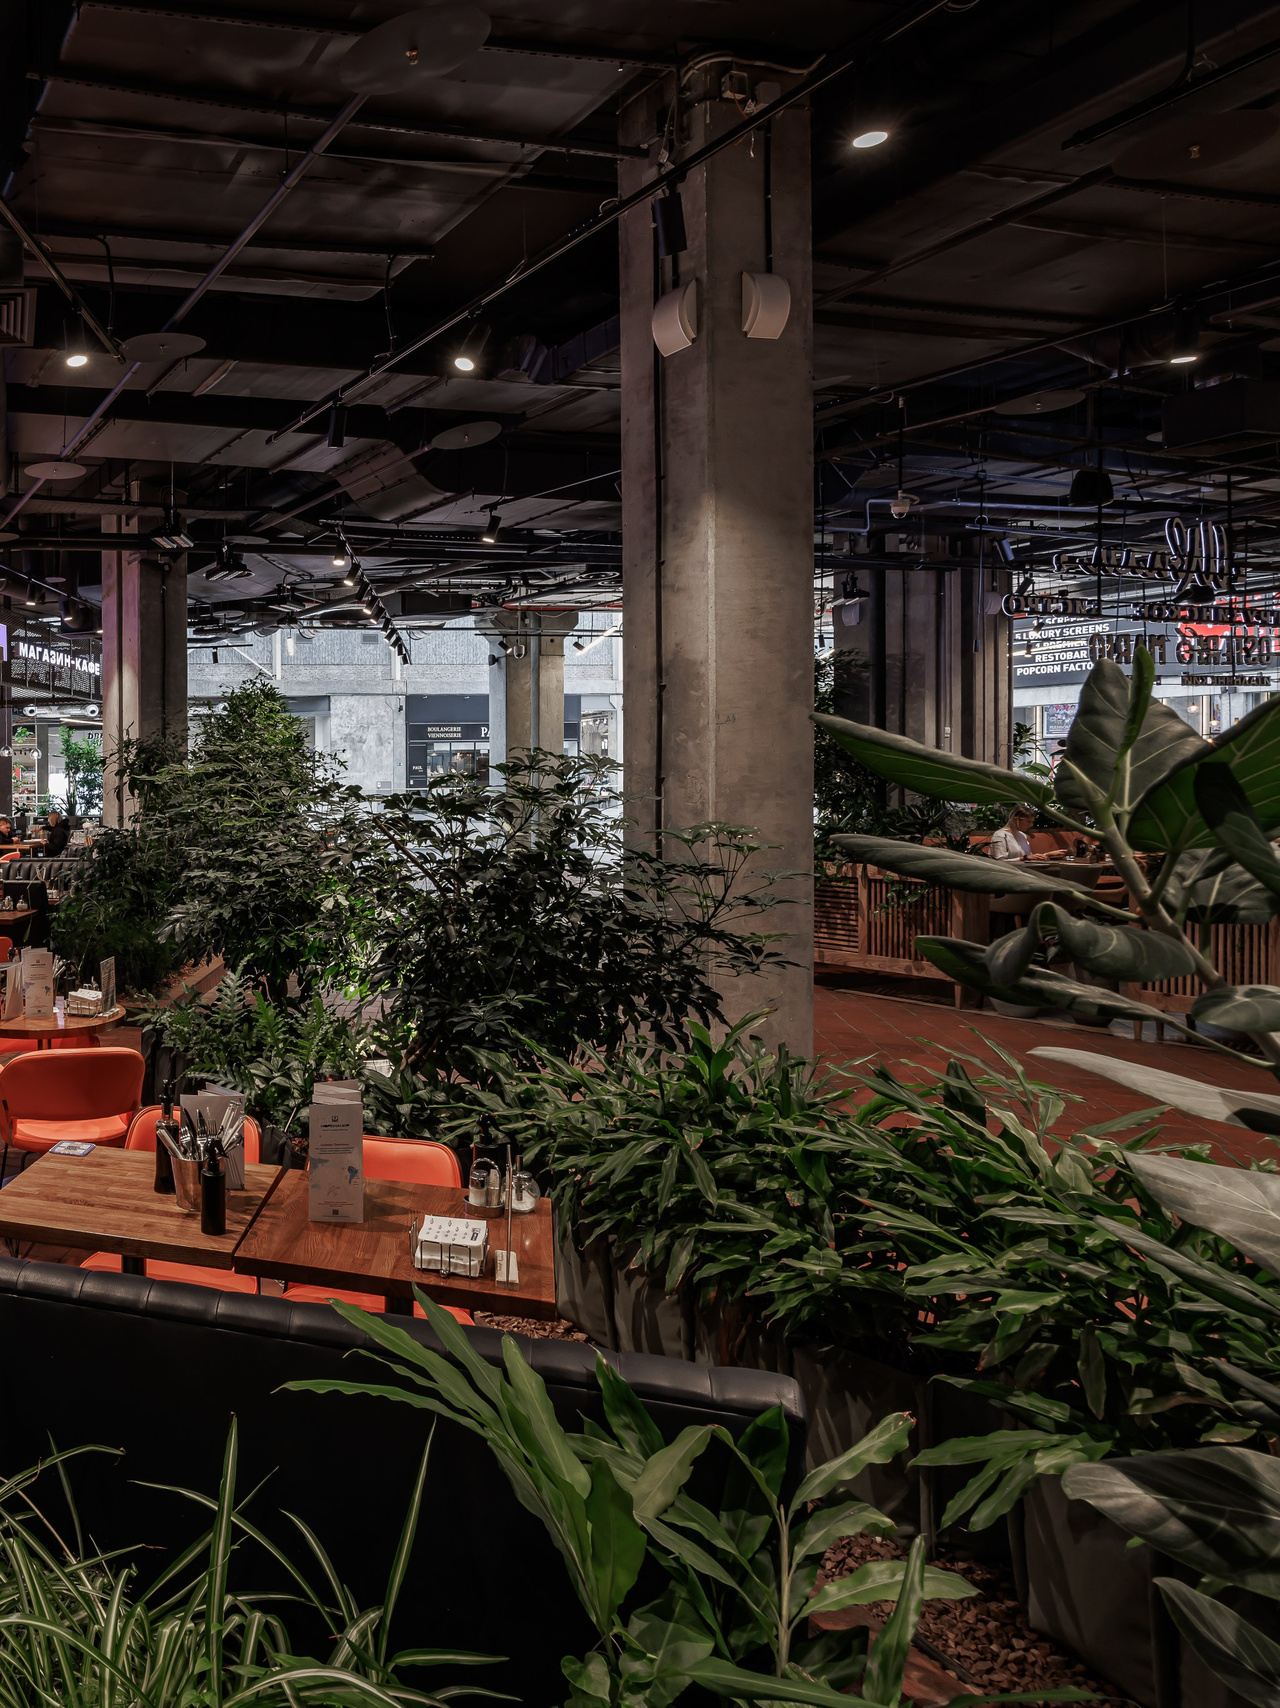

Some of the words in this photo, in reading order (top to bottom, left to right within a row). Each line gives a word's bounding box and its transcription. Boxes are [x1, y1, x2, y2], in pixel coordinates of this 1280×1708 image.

[1023, 628, 1061, 641] LUXURY
[1062, 623, 1110, 637] SCREENS
[19, 642, 101, 676] МАГАЗИН-КАФЕ
[1035, 650, 1088, 663] RESTOBAR
[1016, 664, 1062, 676] POPCORN
[481, 727, 489, 738] P
